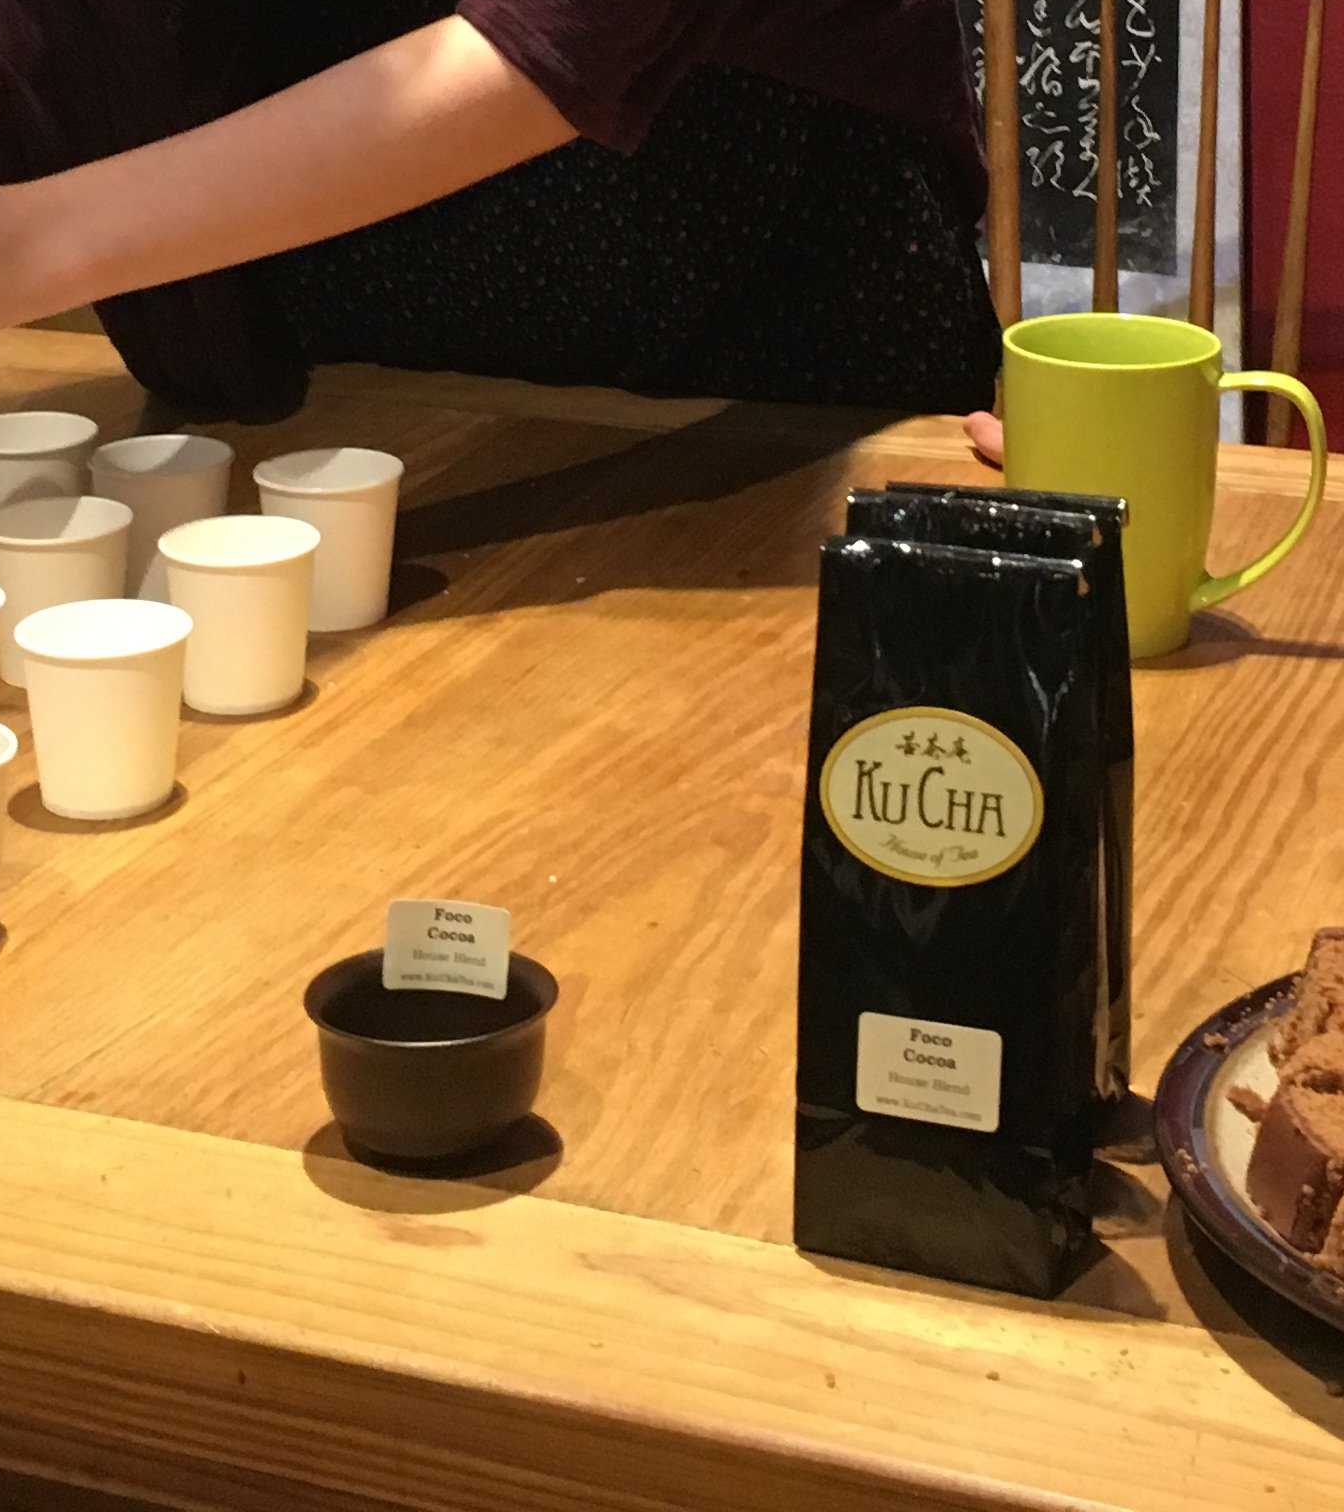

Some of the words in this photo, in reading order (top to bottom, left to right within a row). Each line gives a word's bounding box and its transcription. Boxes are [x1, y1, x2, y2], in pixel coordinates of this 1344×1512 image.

[434, 908, 473, 925] Foco
[427, 926, 476, 944] Cocoa
[910, 1027, 953, 1048] Foco
[903, 1048, 958, 1070] Cocoa
